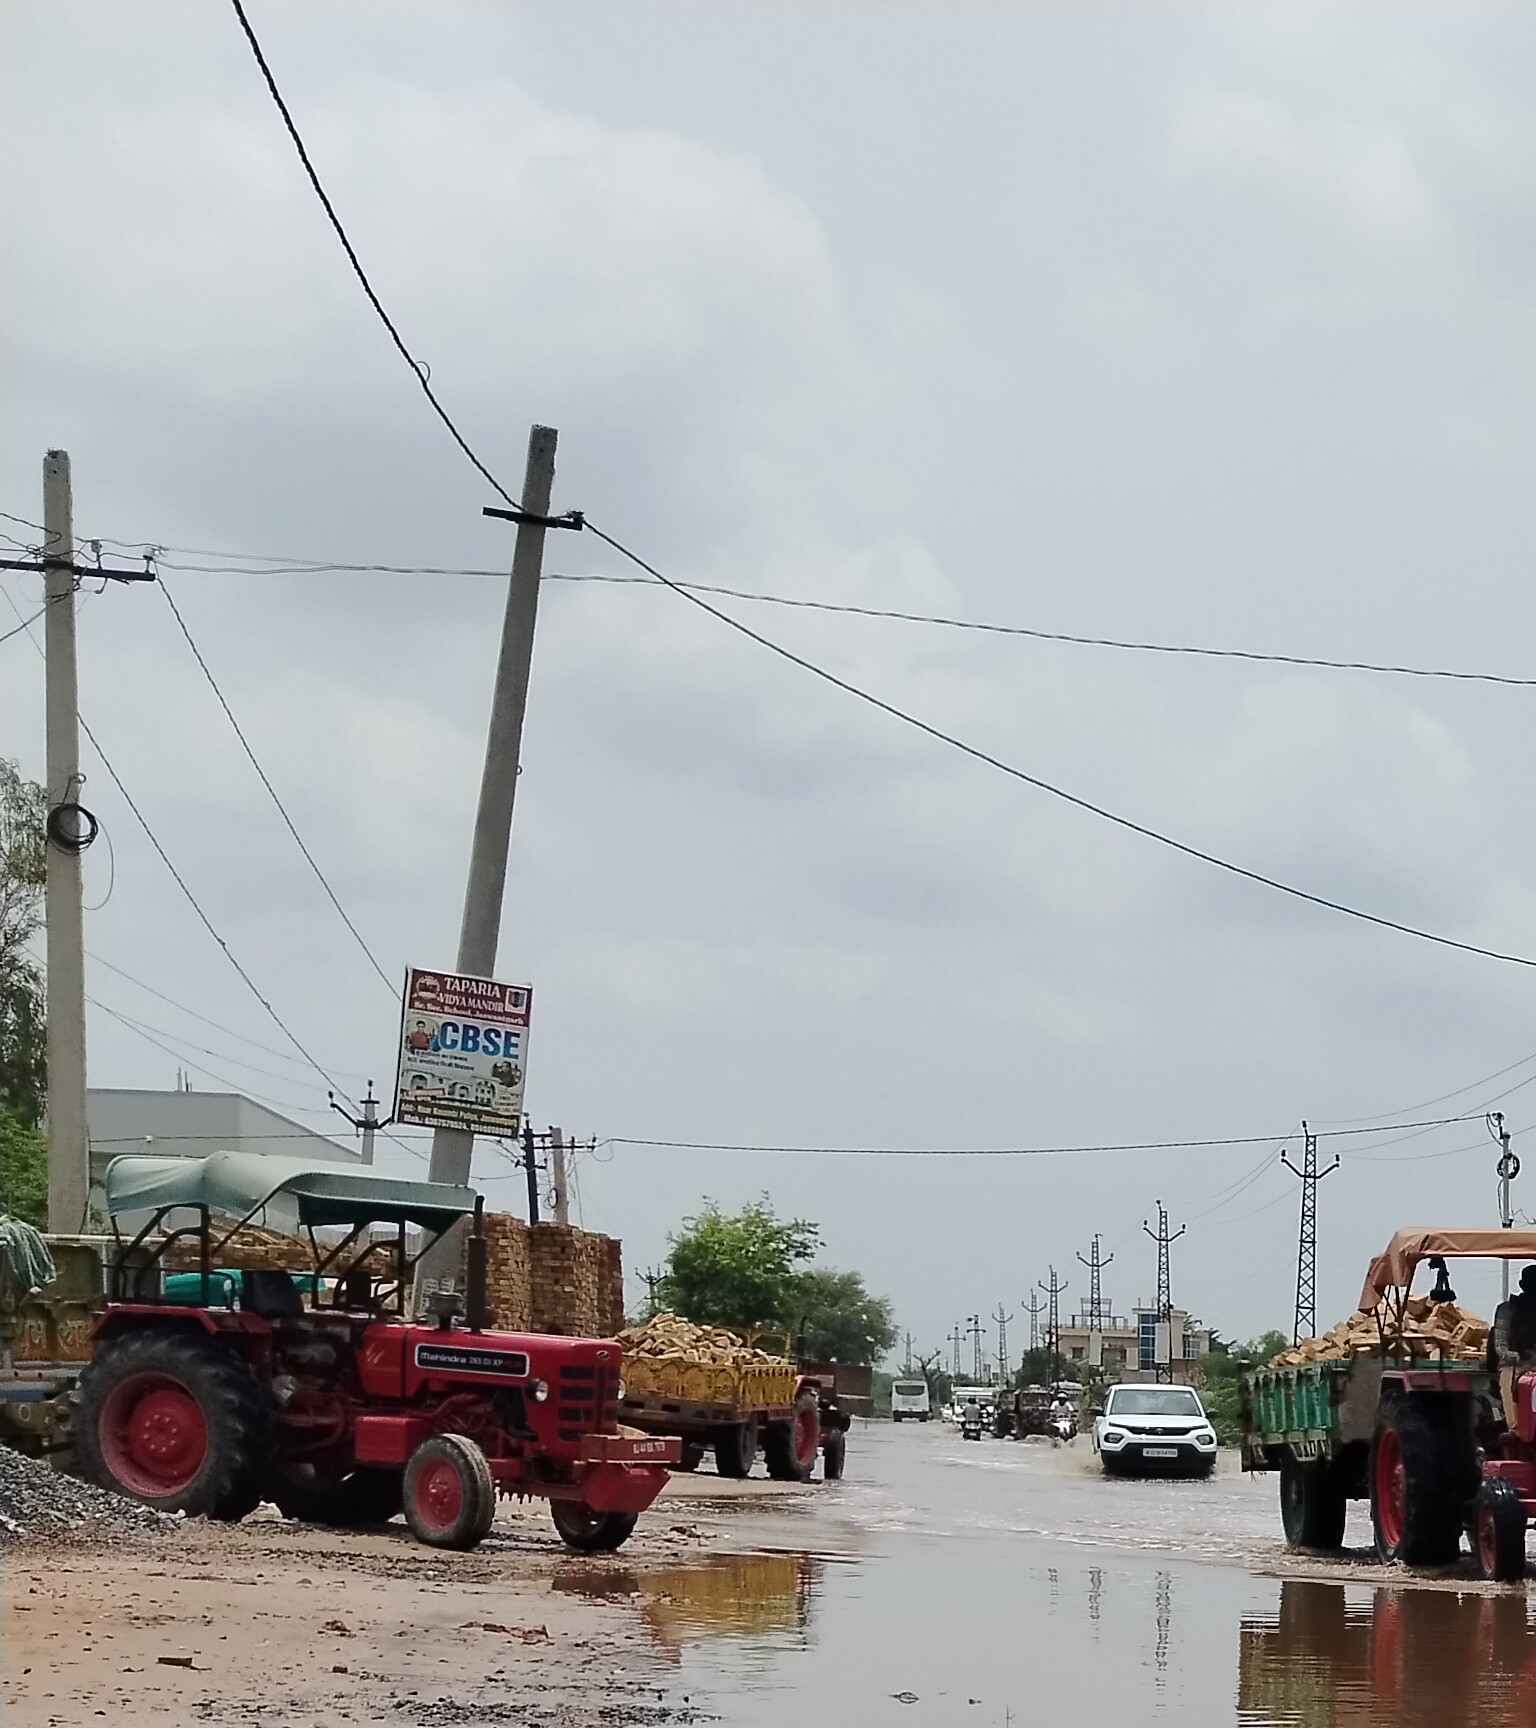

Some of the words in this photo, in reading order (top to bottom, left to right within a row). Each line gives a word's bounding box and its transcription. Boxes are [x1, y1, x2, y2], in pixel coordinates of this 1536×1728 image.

[444, 977, 501, 998] TAPARIA
[438, 993, 467, 1008] VIDYA
[466, 997, 504, 1013] MANDIR
[440, 1021, 521, 1060] CBSE
